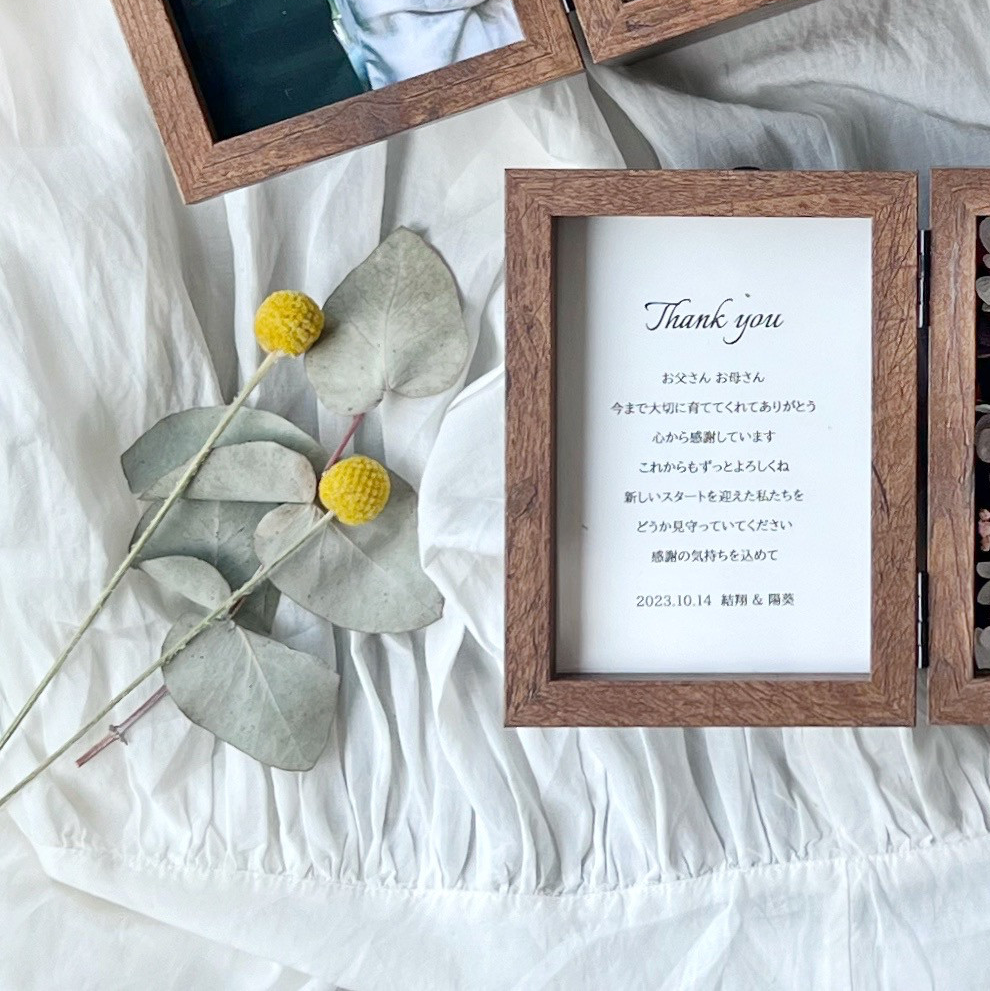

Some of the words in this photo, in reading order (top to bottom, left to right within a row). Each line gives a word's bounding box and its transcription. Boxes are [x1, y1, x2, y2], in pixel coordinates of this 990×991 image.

[645, 298, 733, 330] Thank
[723, 312, 784, 345] you
[662, 372, 711, 384] お父さん
[715, 372, 765, 384] お母さん
[610, 400, 816, 414] 今まで大切に育ててくれてありがとう
[652, 429, 776, 444] 心から感謝しています
[638, 460, 790, 474] これからもずっとよろしくね
[624, 489, 804, 504] 新しいスタートを迎えた私たちを
[636, 519, 793, 533] どうか見守っていてください
[651, 549, 778, 563] 感謝の気持ちを込めて
[636, 594, 712, 607] 2023.10.14
[752, 595, 763, 606] &
